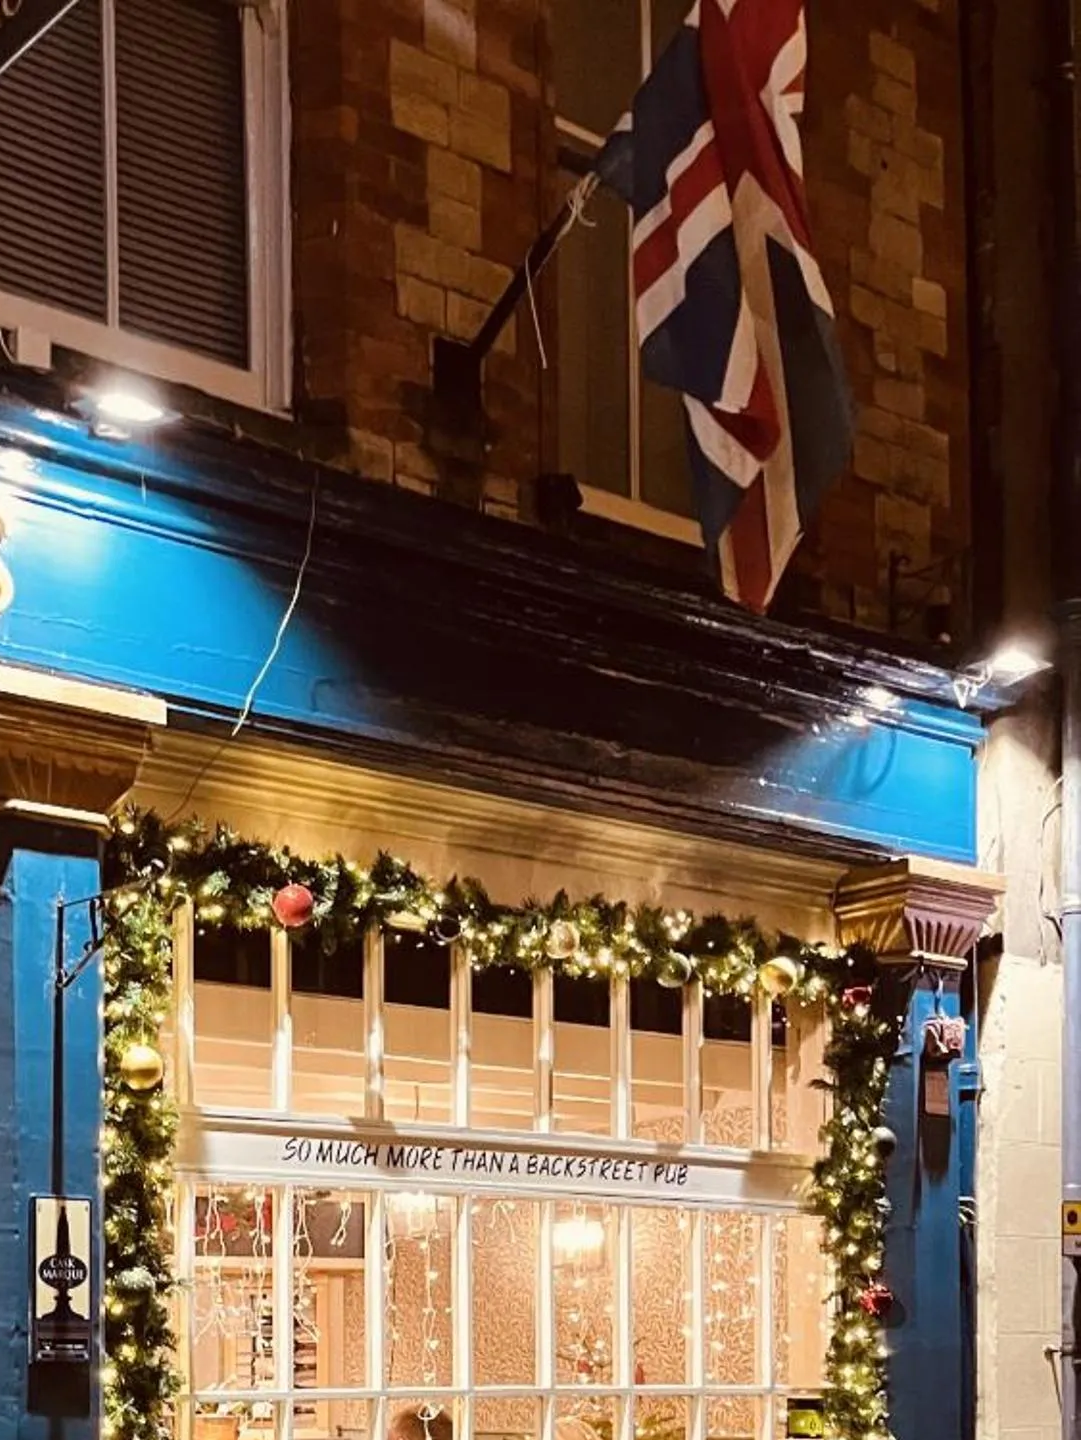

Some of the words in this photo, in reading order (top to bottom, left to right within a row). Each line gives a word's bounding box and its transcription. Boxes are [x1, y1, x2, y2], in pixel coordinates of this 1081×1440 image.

[282, 1136, 310, 1161] SO
[316, 1140, 379, 1166] MUCH
[386, 1144, 444, 1170] MORE
[451, 1149, 504, 1174] THAN
[508, 1154, 519, 1174] A
[526, 1154, 649, 1182] BACKSTREET
[654, 1162, 689, 1186] PUB
